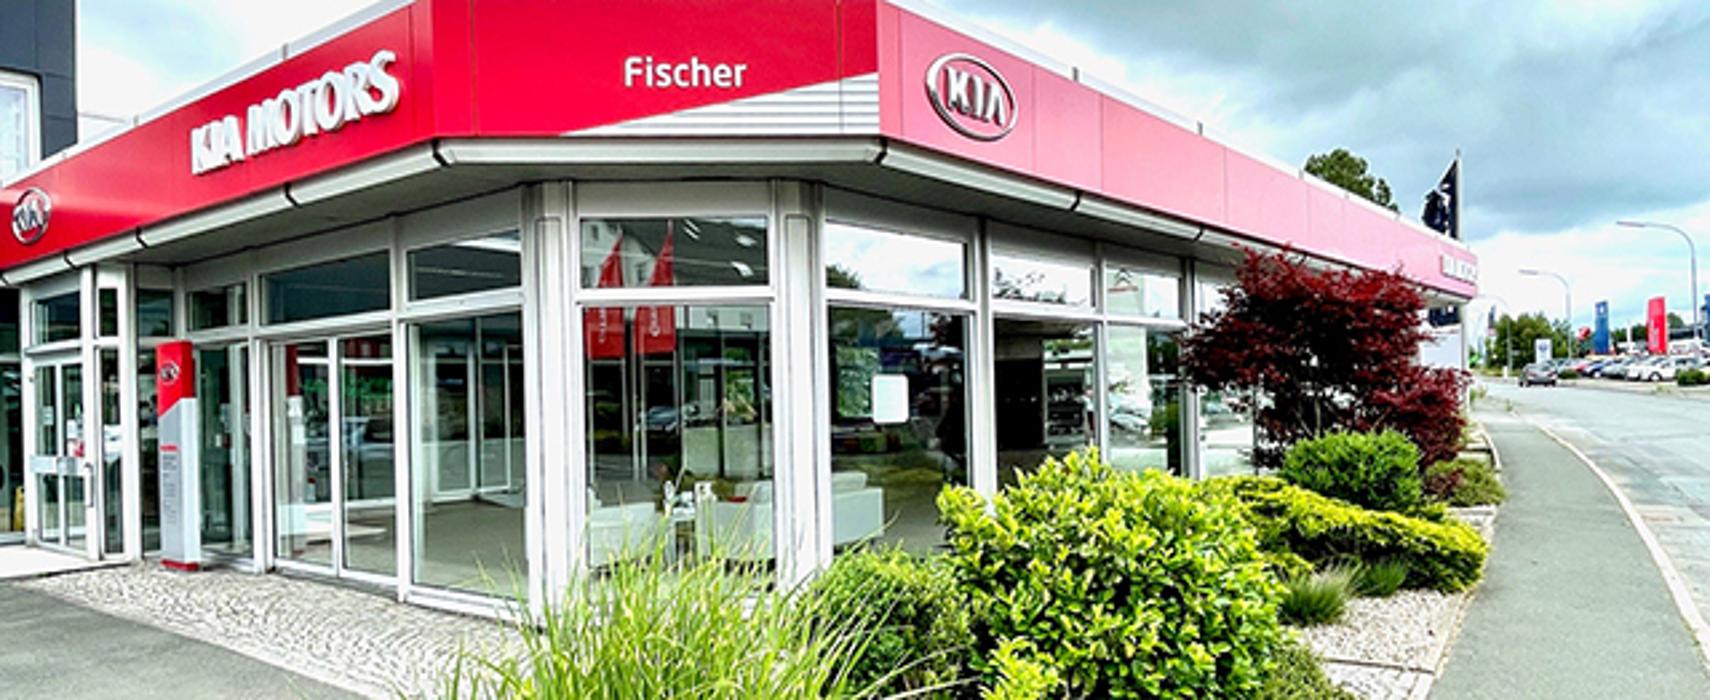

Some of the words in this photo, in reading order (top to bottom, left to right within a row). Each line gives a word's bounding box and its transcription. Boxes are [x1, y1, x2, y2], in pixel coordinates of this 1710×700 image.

[624, 56, 748, 88] Fischer
[944, 65, 1006, 126] KIA
[191, 115, 245, 175] KIA
[246, 50, 399, 156] MOTORS
